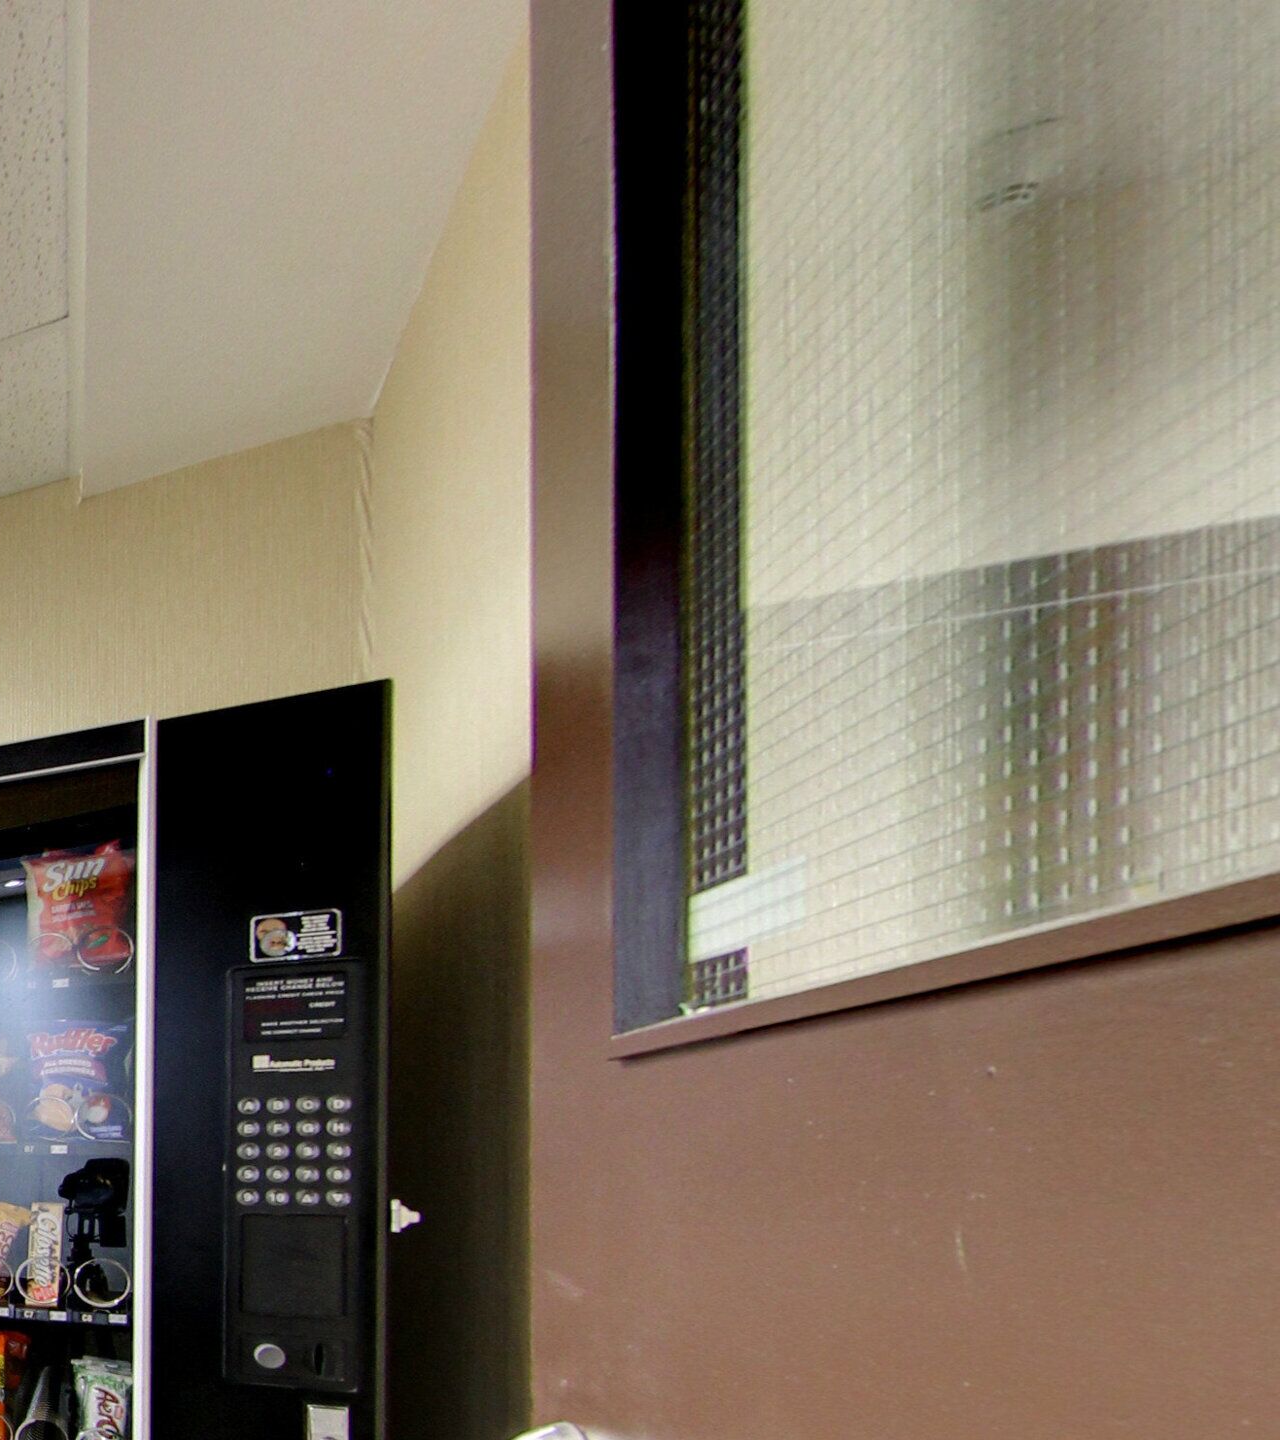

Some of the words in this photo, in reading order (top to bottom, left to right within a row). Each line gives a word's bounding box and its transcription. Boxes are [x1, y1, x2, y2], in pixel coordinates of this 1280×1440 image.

[43, 857, 106, 892] Sun
[51, 877, 97, 901] Chips
[308, 1000, 336, 1008] CREDIT
